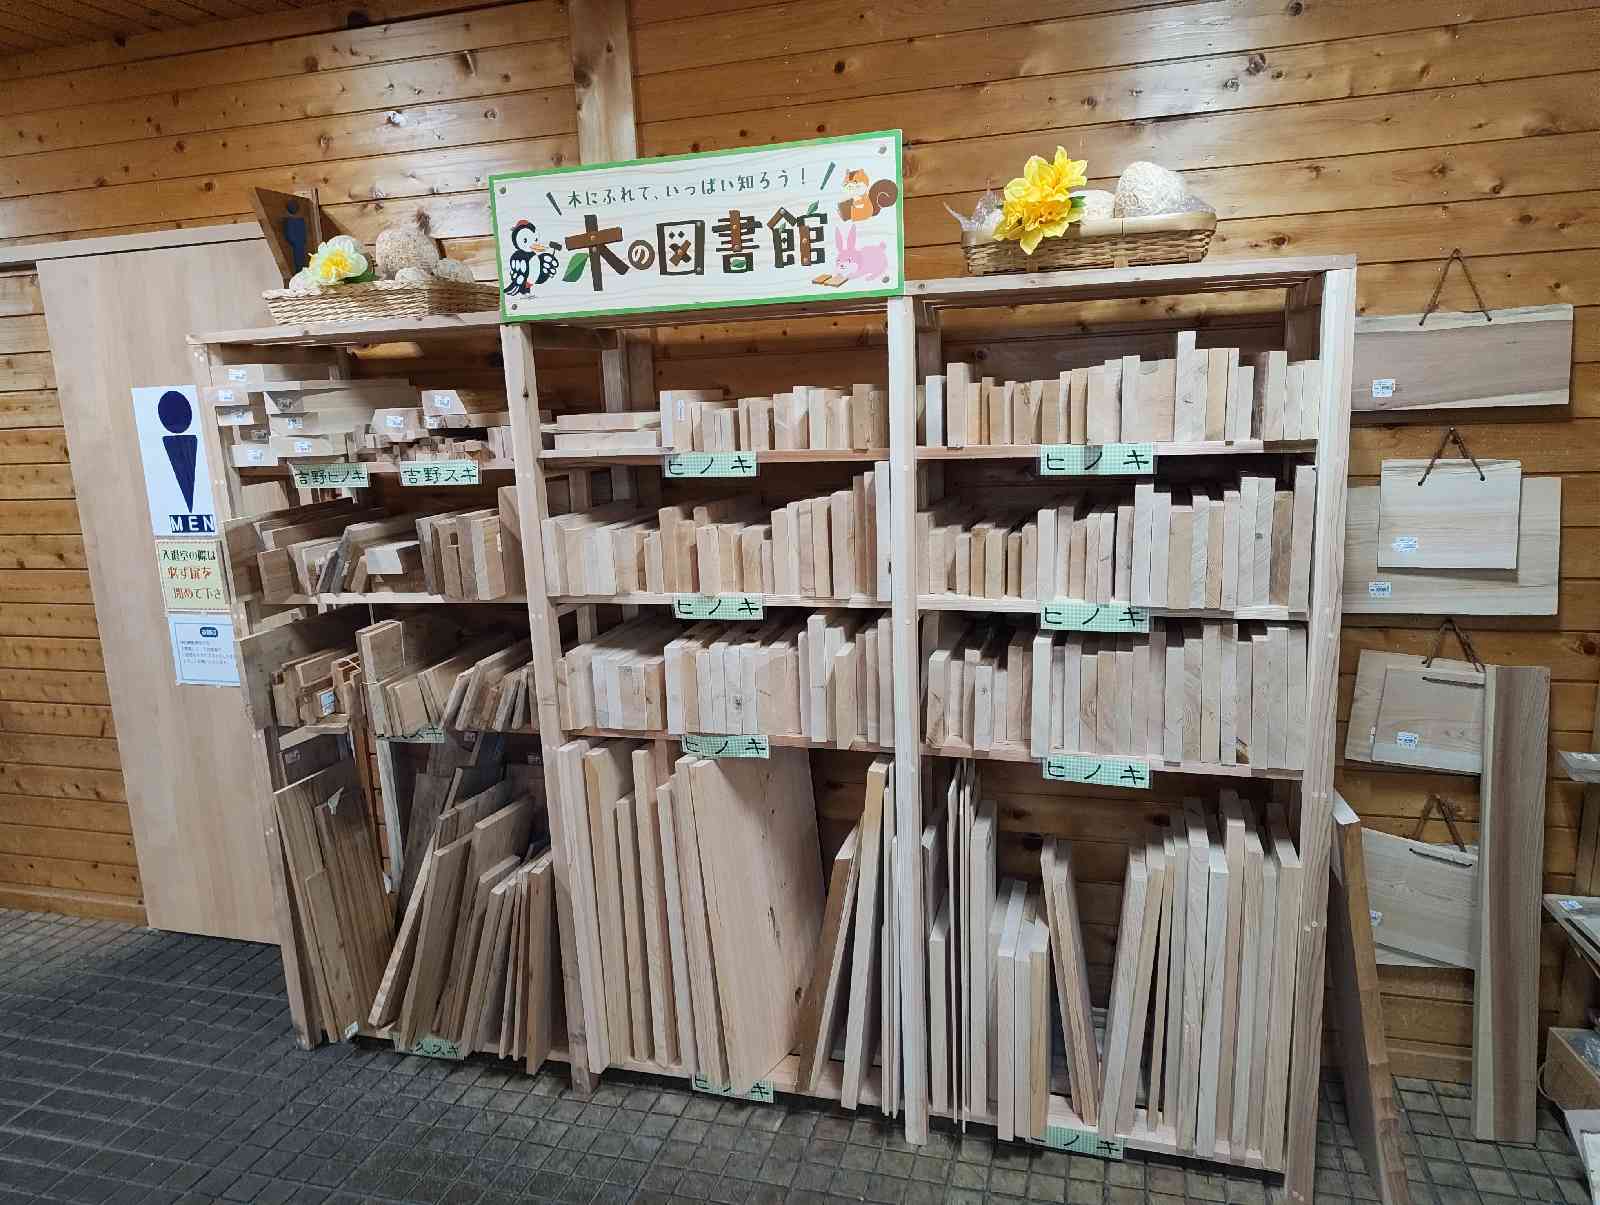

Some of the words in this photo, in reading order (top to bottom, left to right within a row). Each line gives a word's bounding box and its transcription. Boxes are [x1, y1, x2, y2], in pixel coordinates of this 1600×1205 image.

[564, 206, 829, 291] 木の図書館
[668, 455, 752, 475] ヒノキ
[1047, 449, 1149, 471] ヒノキ
[295, 470, 366, 485] 吉野ヒノキ
[402, 466, 477, 484] 吉野スギ
[170, 515, 215, 532] MEN
[678, 597, 760, 615] ヒノキ
[1045, 606, 1144, 627] ヒノキ
[685, 737, 766, 755] ヒノキ
[1047, 761, 1145, 784] ヒノキ
[1030, 1134, 1120, 1154] ノキ
